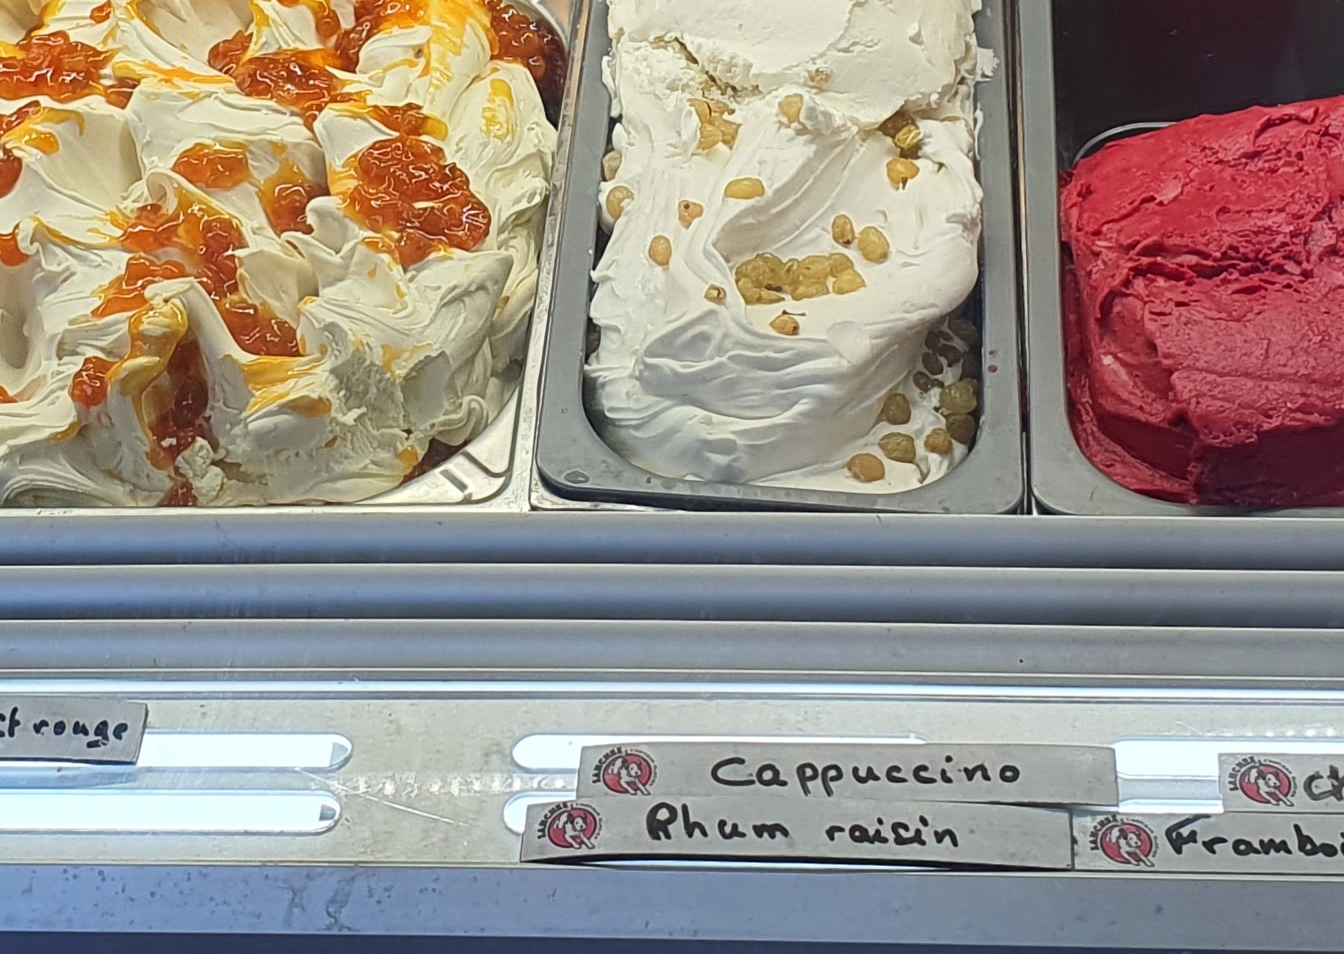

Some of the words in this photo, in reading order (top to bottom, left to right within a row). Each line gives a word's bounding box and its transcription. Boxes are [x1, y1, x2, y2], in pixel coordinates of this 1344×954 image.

[33, 718, 129, 749] rouge
[709, 754, 1021, 798] Cappuccino
[645, 801, 791, 842] Rhum
[824, 814, 960, 849] raisin
